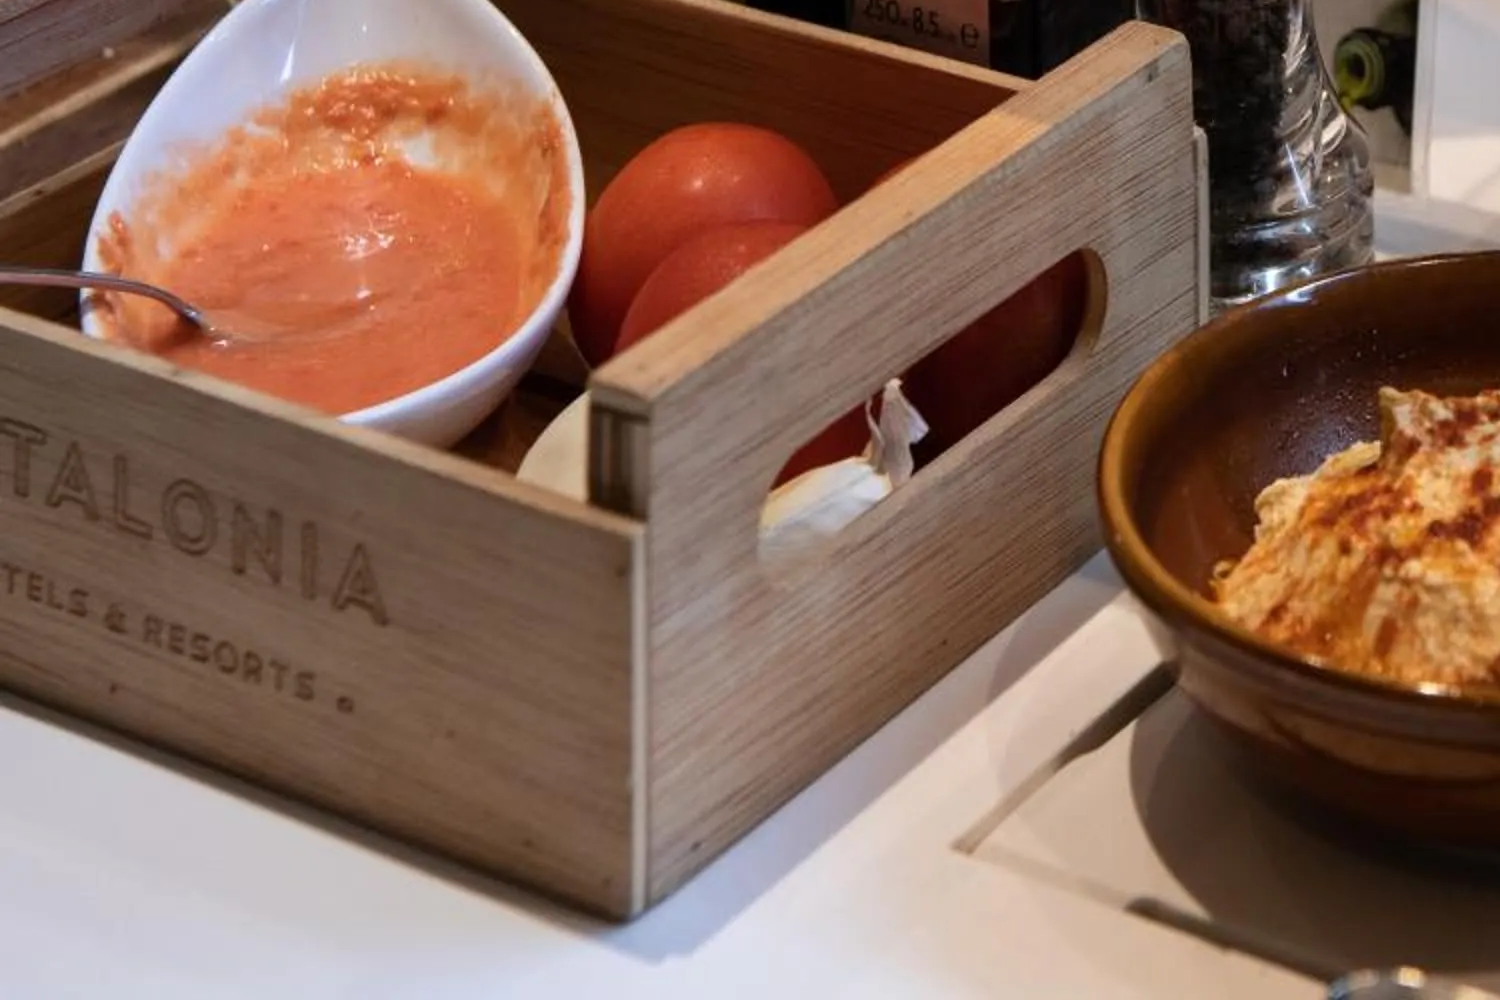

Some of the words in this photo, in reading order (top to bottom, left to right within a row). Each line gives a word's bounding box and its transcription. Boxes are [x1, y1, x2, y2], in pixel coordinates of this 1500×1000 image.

[0, 417, 391, 628] TALONIA
[0, 562, 90, 619] TELS
[103, 602, 129, 635] &
[142, 613, 318, 702] RESORTS
